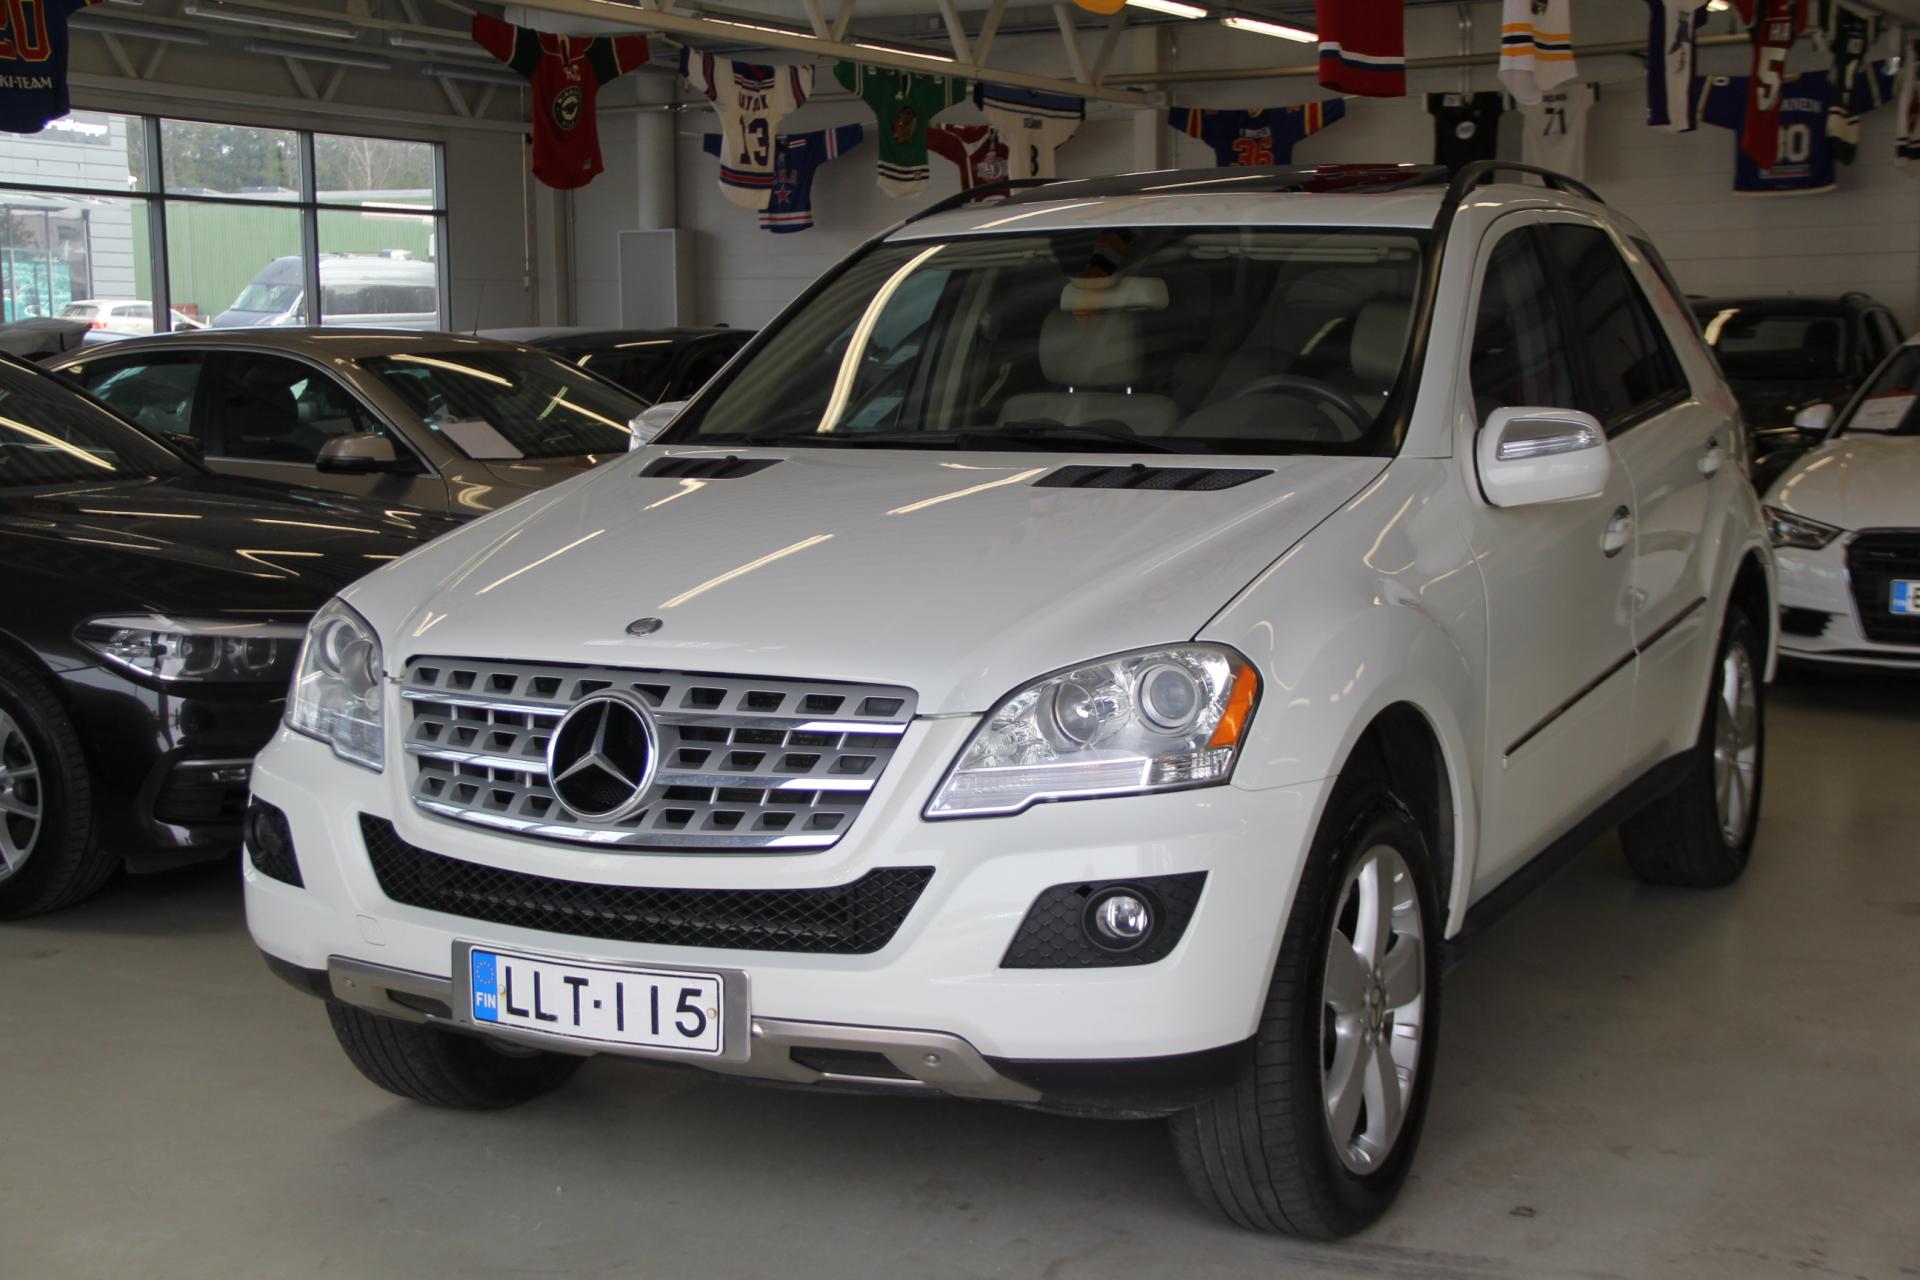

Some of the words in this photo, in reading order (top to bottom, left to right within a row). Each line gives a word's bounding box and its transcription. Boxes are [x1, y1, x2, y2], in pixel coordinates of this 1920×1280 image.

[1757, 46, 1787, 111] 5
[739, 115, 769, 166] 13
[1543, 108, 1566, 136] 71
[476, 991, 497, 1009] FIN
